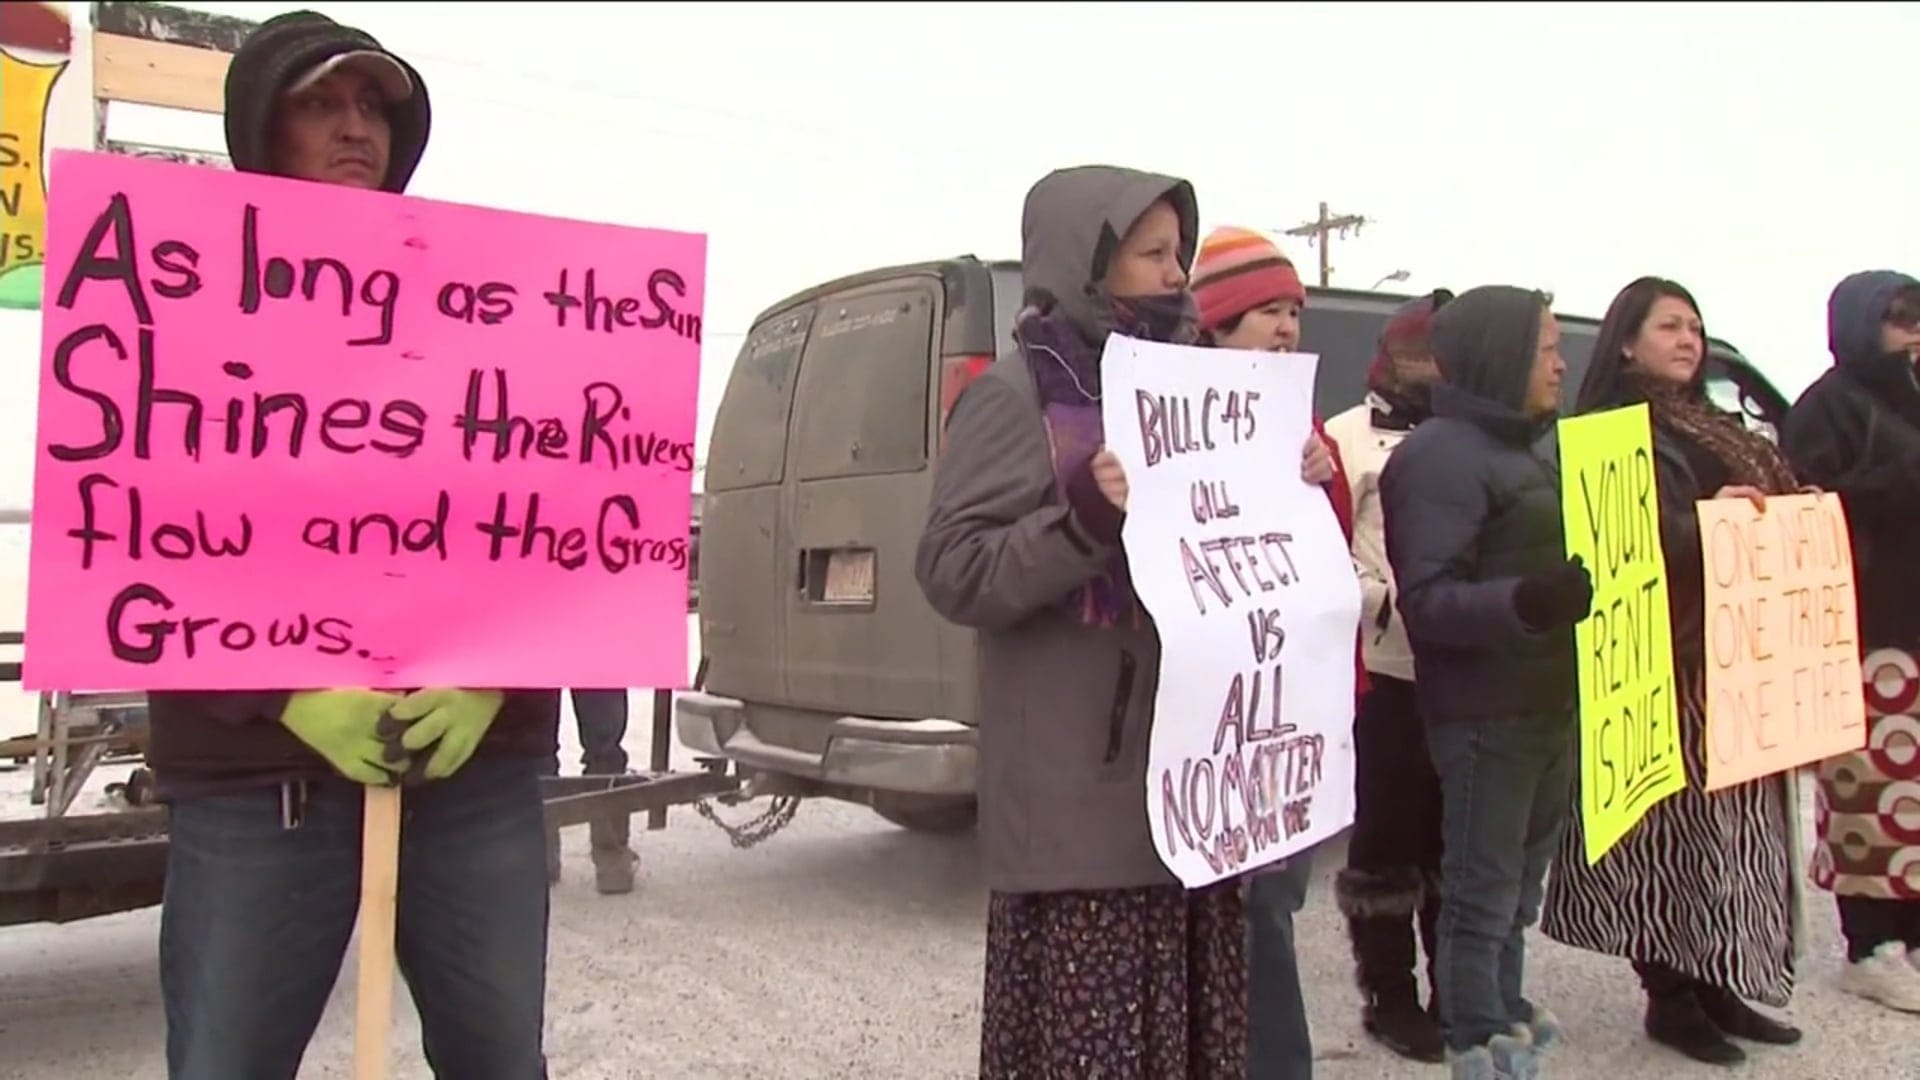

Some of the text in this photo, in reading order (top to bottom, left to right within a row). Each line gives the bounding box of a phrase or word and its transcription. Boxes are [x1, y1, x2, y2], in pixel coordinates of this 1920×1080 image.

[56, 191, 202, 325] As
[238, 203, 399, 346] long
[437, 282, 519, 325] as
[543, 268, 640, 333] the
[639, 268, 702, 344] Sun
[48, 323, 694, 471] Shines the Rivers
[1135, 388, 1200, 467] BILL
[67, 473, 689, 574] flow and the Grass
[1580, 447, 1654, 592] YOUR
[1710, 517, 1772, 588] ONE
[106, 582, 371, 665] Grows.
[1179, 532, 1300, 615] AFFECT
[1247, 608, 1285, 664] US
[1593, 577, 1659, 701] RENT
[1712, 582, 1852, 669] ONE TRIBE
[1213, 664, 1297, 756] ALL
[1593, 674, 1674, 816] IS DUE!
[1711, 658, 1860, 766] ONE FIRE
[1162, 757, 1216, 857] NO
